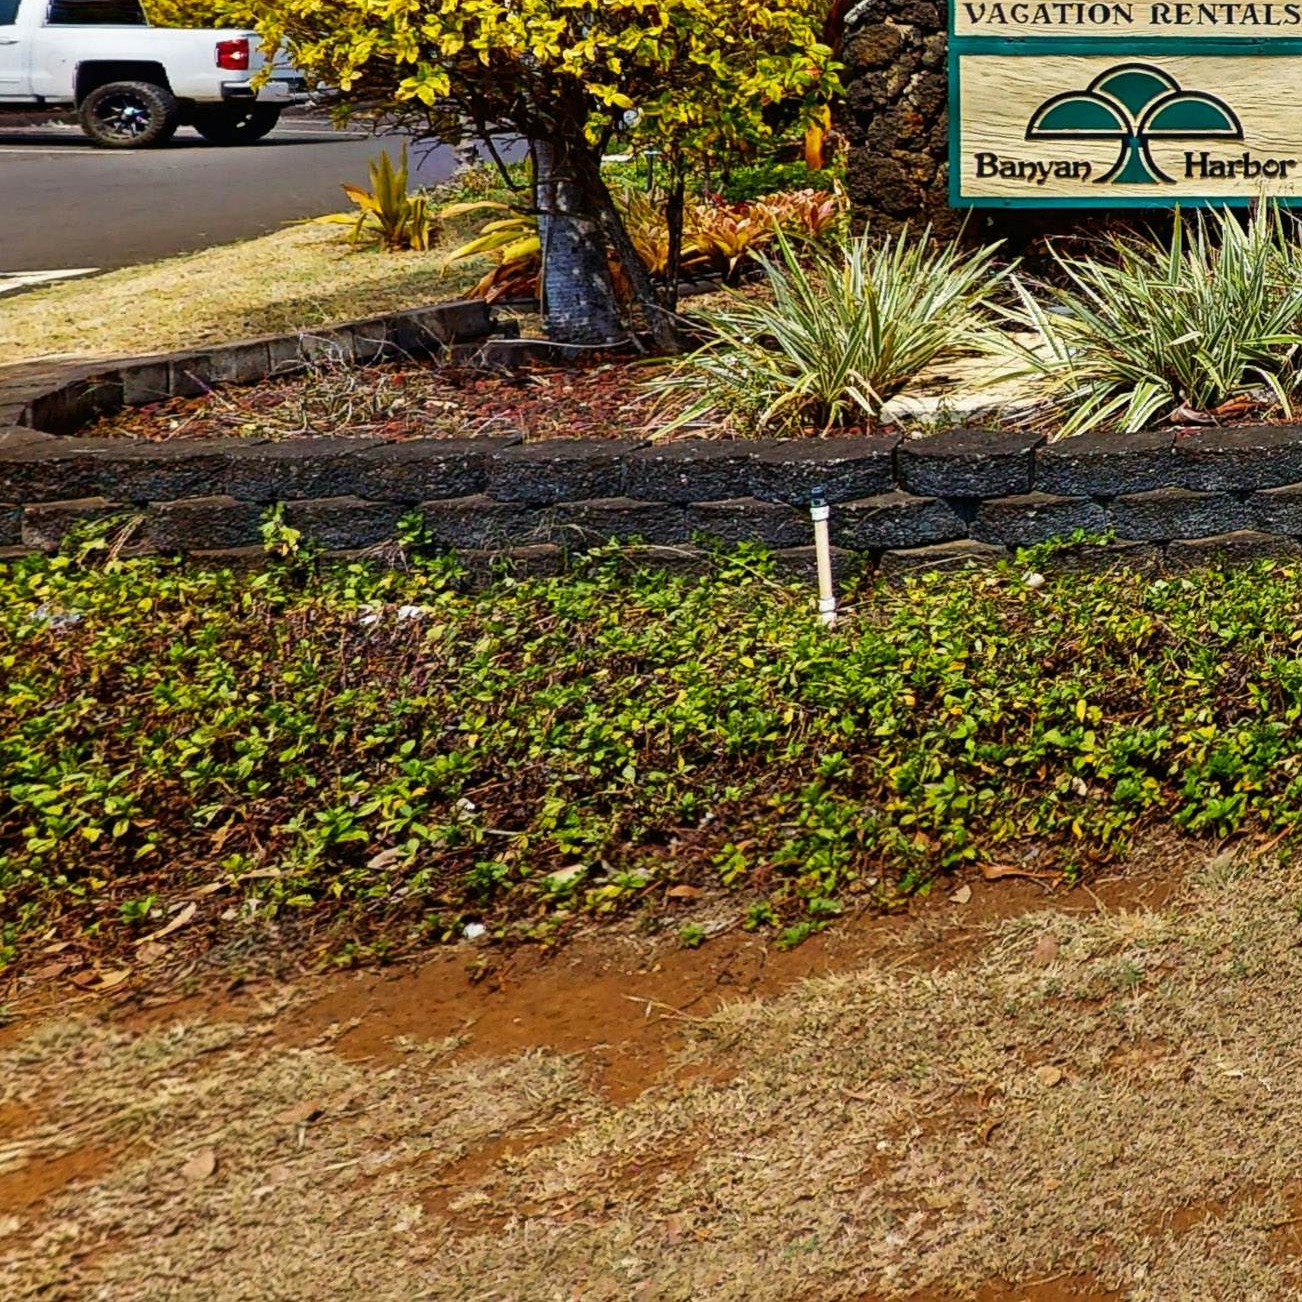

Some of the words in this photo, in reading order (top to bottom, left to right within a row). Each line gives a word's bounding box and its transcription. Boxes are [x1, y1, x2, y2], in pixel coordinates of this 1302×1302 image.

[963, 2, 1134, 26] VACATION
[1150, 2, 1302, 26] RENTALS
[974, 151, 1093, 183] Banyan
[1184, 151, 1297, 179] Harbor
